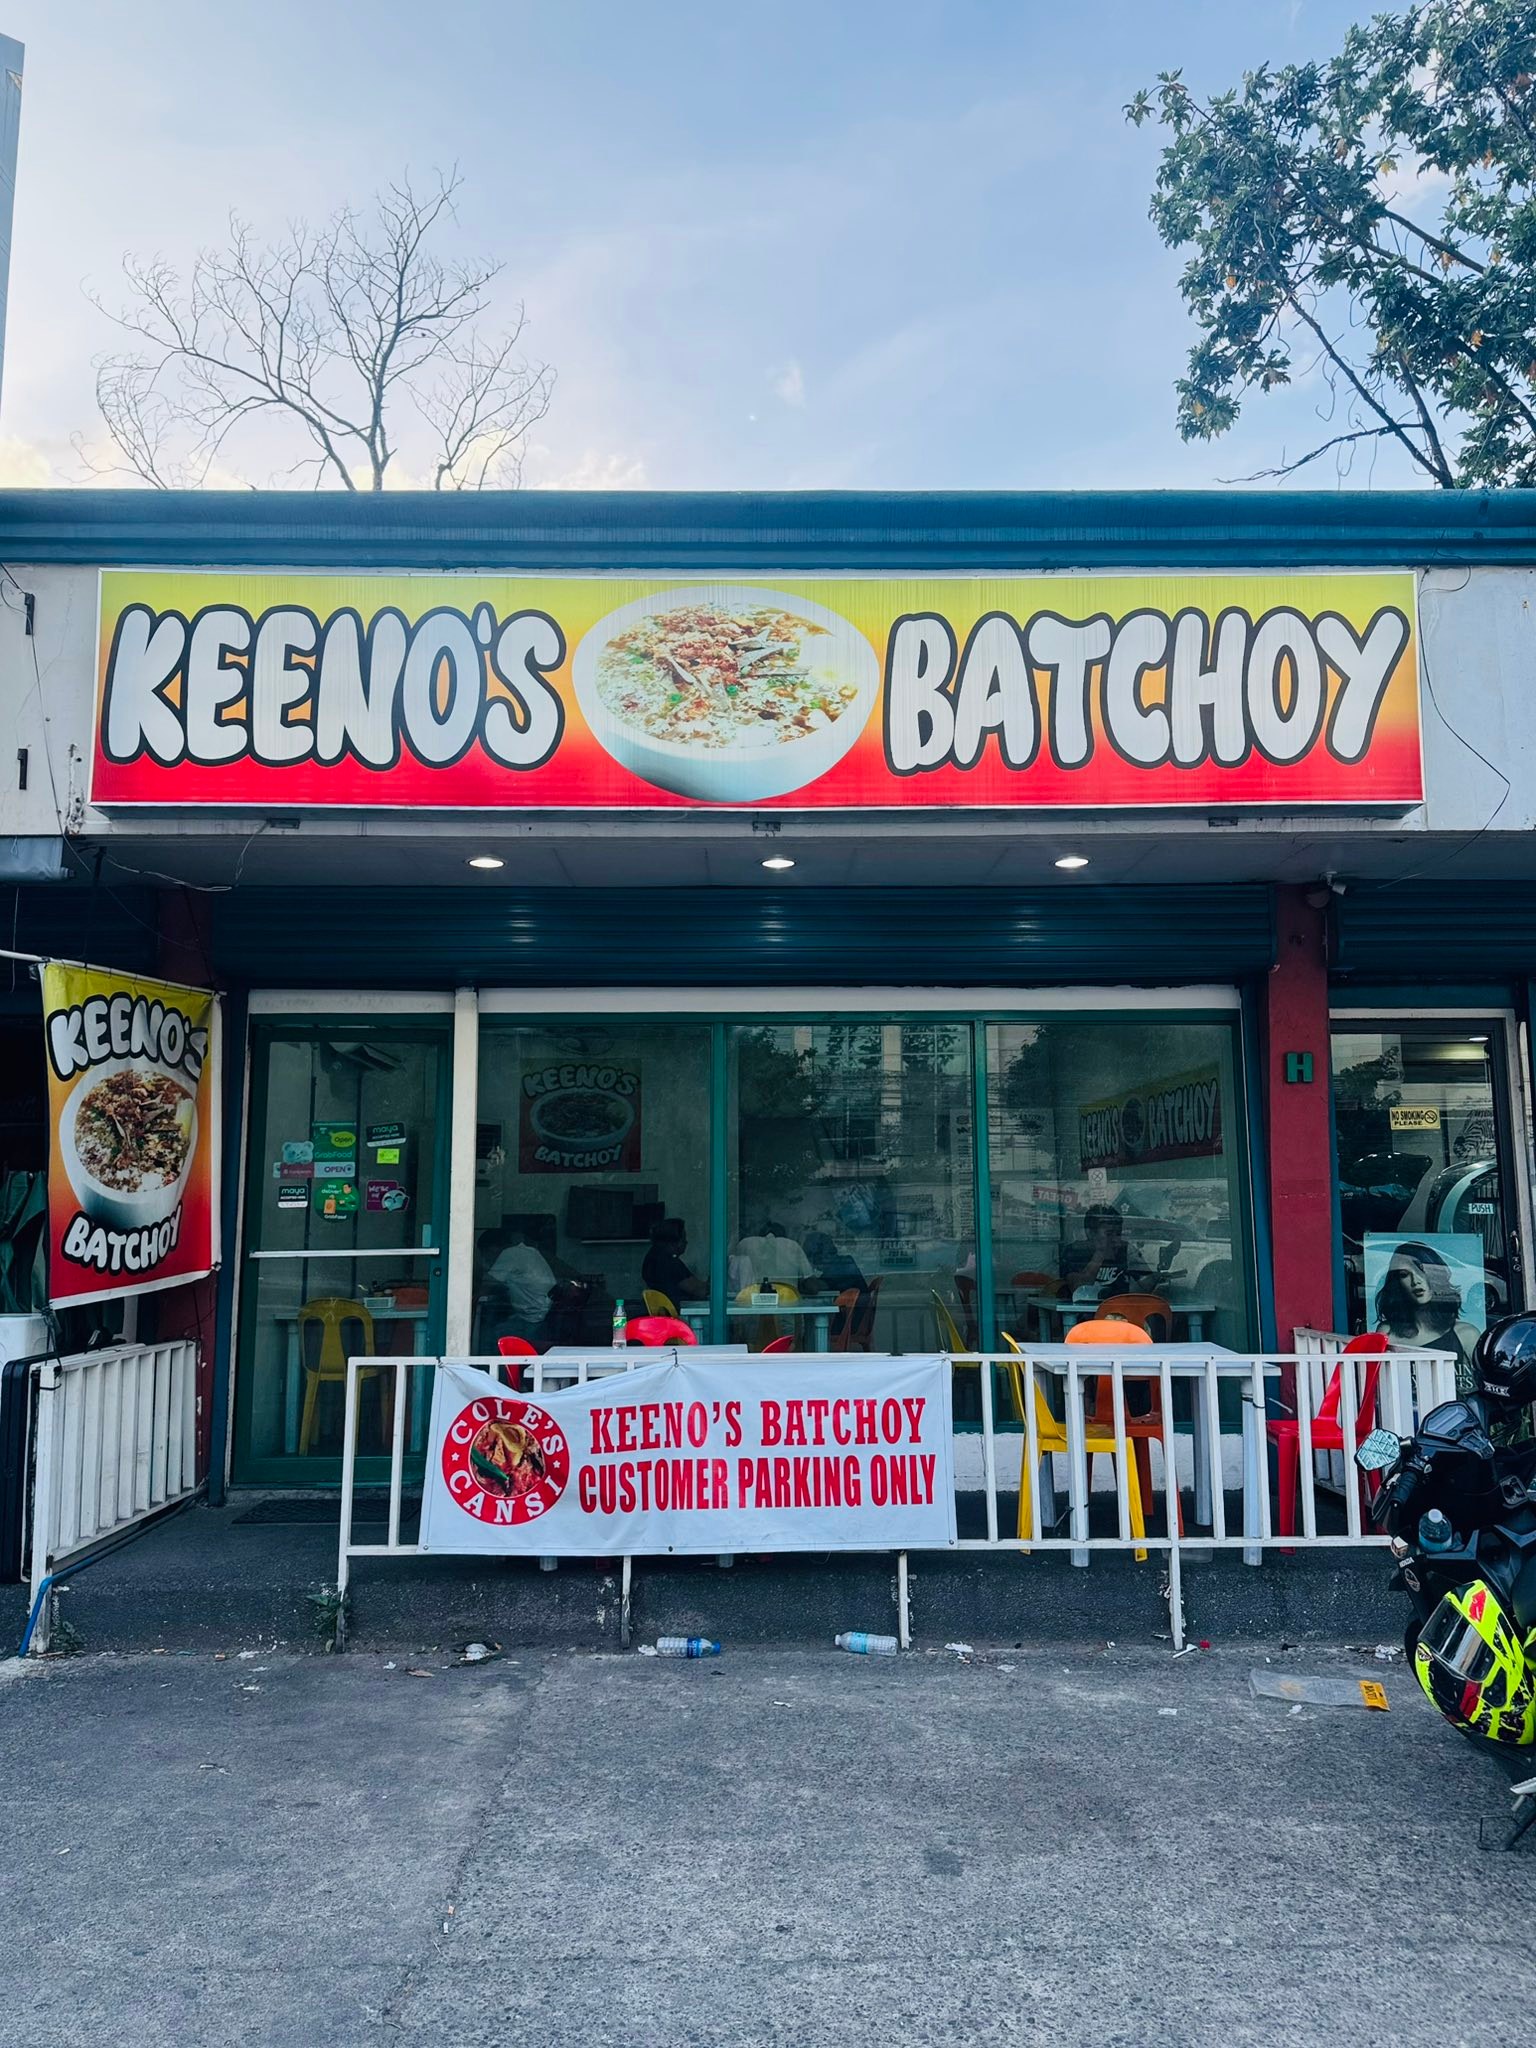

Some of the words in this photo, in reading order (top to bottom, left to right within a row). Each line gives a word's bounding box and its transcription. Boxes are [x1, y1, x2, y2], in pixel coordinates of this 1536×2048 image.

[103, 602, 565, 770] KEENO'S
[884, 607, 1410, 775] BATCHOY
[48, 993, 208, 1080] KEENO'S
[522, 1064, 640, 1098] KEENO'S
[1286, 1052, 1314, 1083] H
[372, 1125, 398, 1134] maya
[1148, 1078, 1218, 1149] BATCHOY
[1391, 1110, 1399, 1120] NO
[1400, 1110, 1425, 1120] SMOKING
[314, 1150, 353, 1159] GrabFood
[334, 1136, 352, 1144] Open
[532, 1144, 623, 1168] BATCHOY
[324, 1165, 346, 1173] OPEN
[281, 1188, 306, 1196] maya
[1471, 1204, 1492, 1213] PUSH
[63, 1202, 183, 1274] BATCHOY
[451, 1399, 564, 1456] COLE'S
[589, 1401, 742, 1454] KEENO'S
[760, 1397, 926, 1447] BATCHOY
[447, 1467, 563, 1524] CANSI
[578, 1459, 728, 1514] CUSTOMER
[738, 1455, 859, 1508] PARKING
[871, 1454, 936, 1504] ONLY
